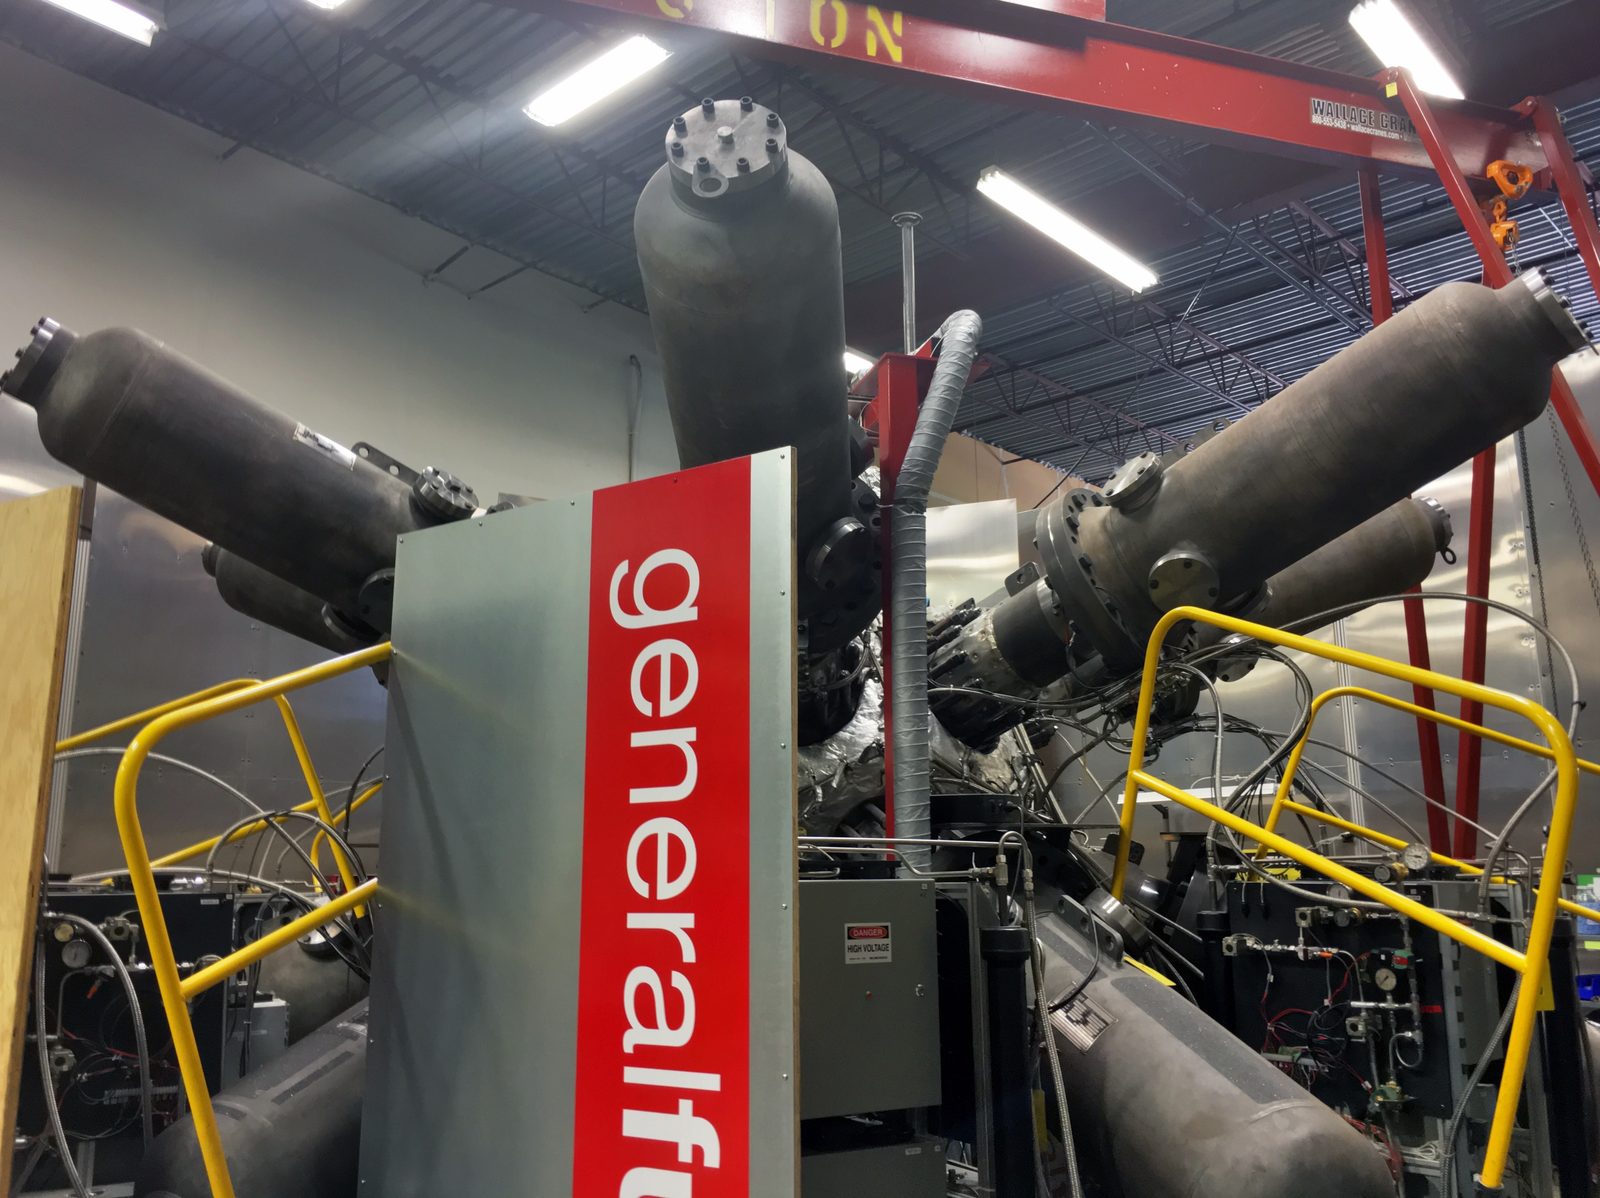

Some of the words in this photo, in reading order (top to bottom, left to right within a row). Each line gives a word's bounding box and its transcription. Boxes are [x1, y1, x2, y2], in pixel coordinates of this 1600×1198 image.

[1311, 98, 1375, 127] WALLACE
[853, 928, 883, 937] DANGER
[848, 945, 862, 953] HIGH
[863, 944, 889, 952] VOLTAGE
